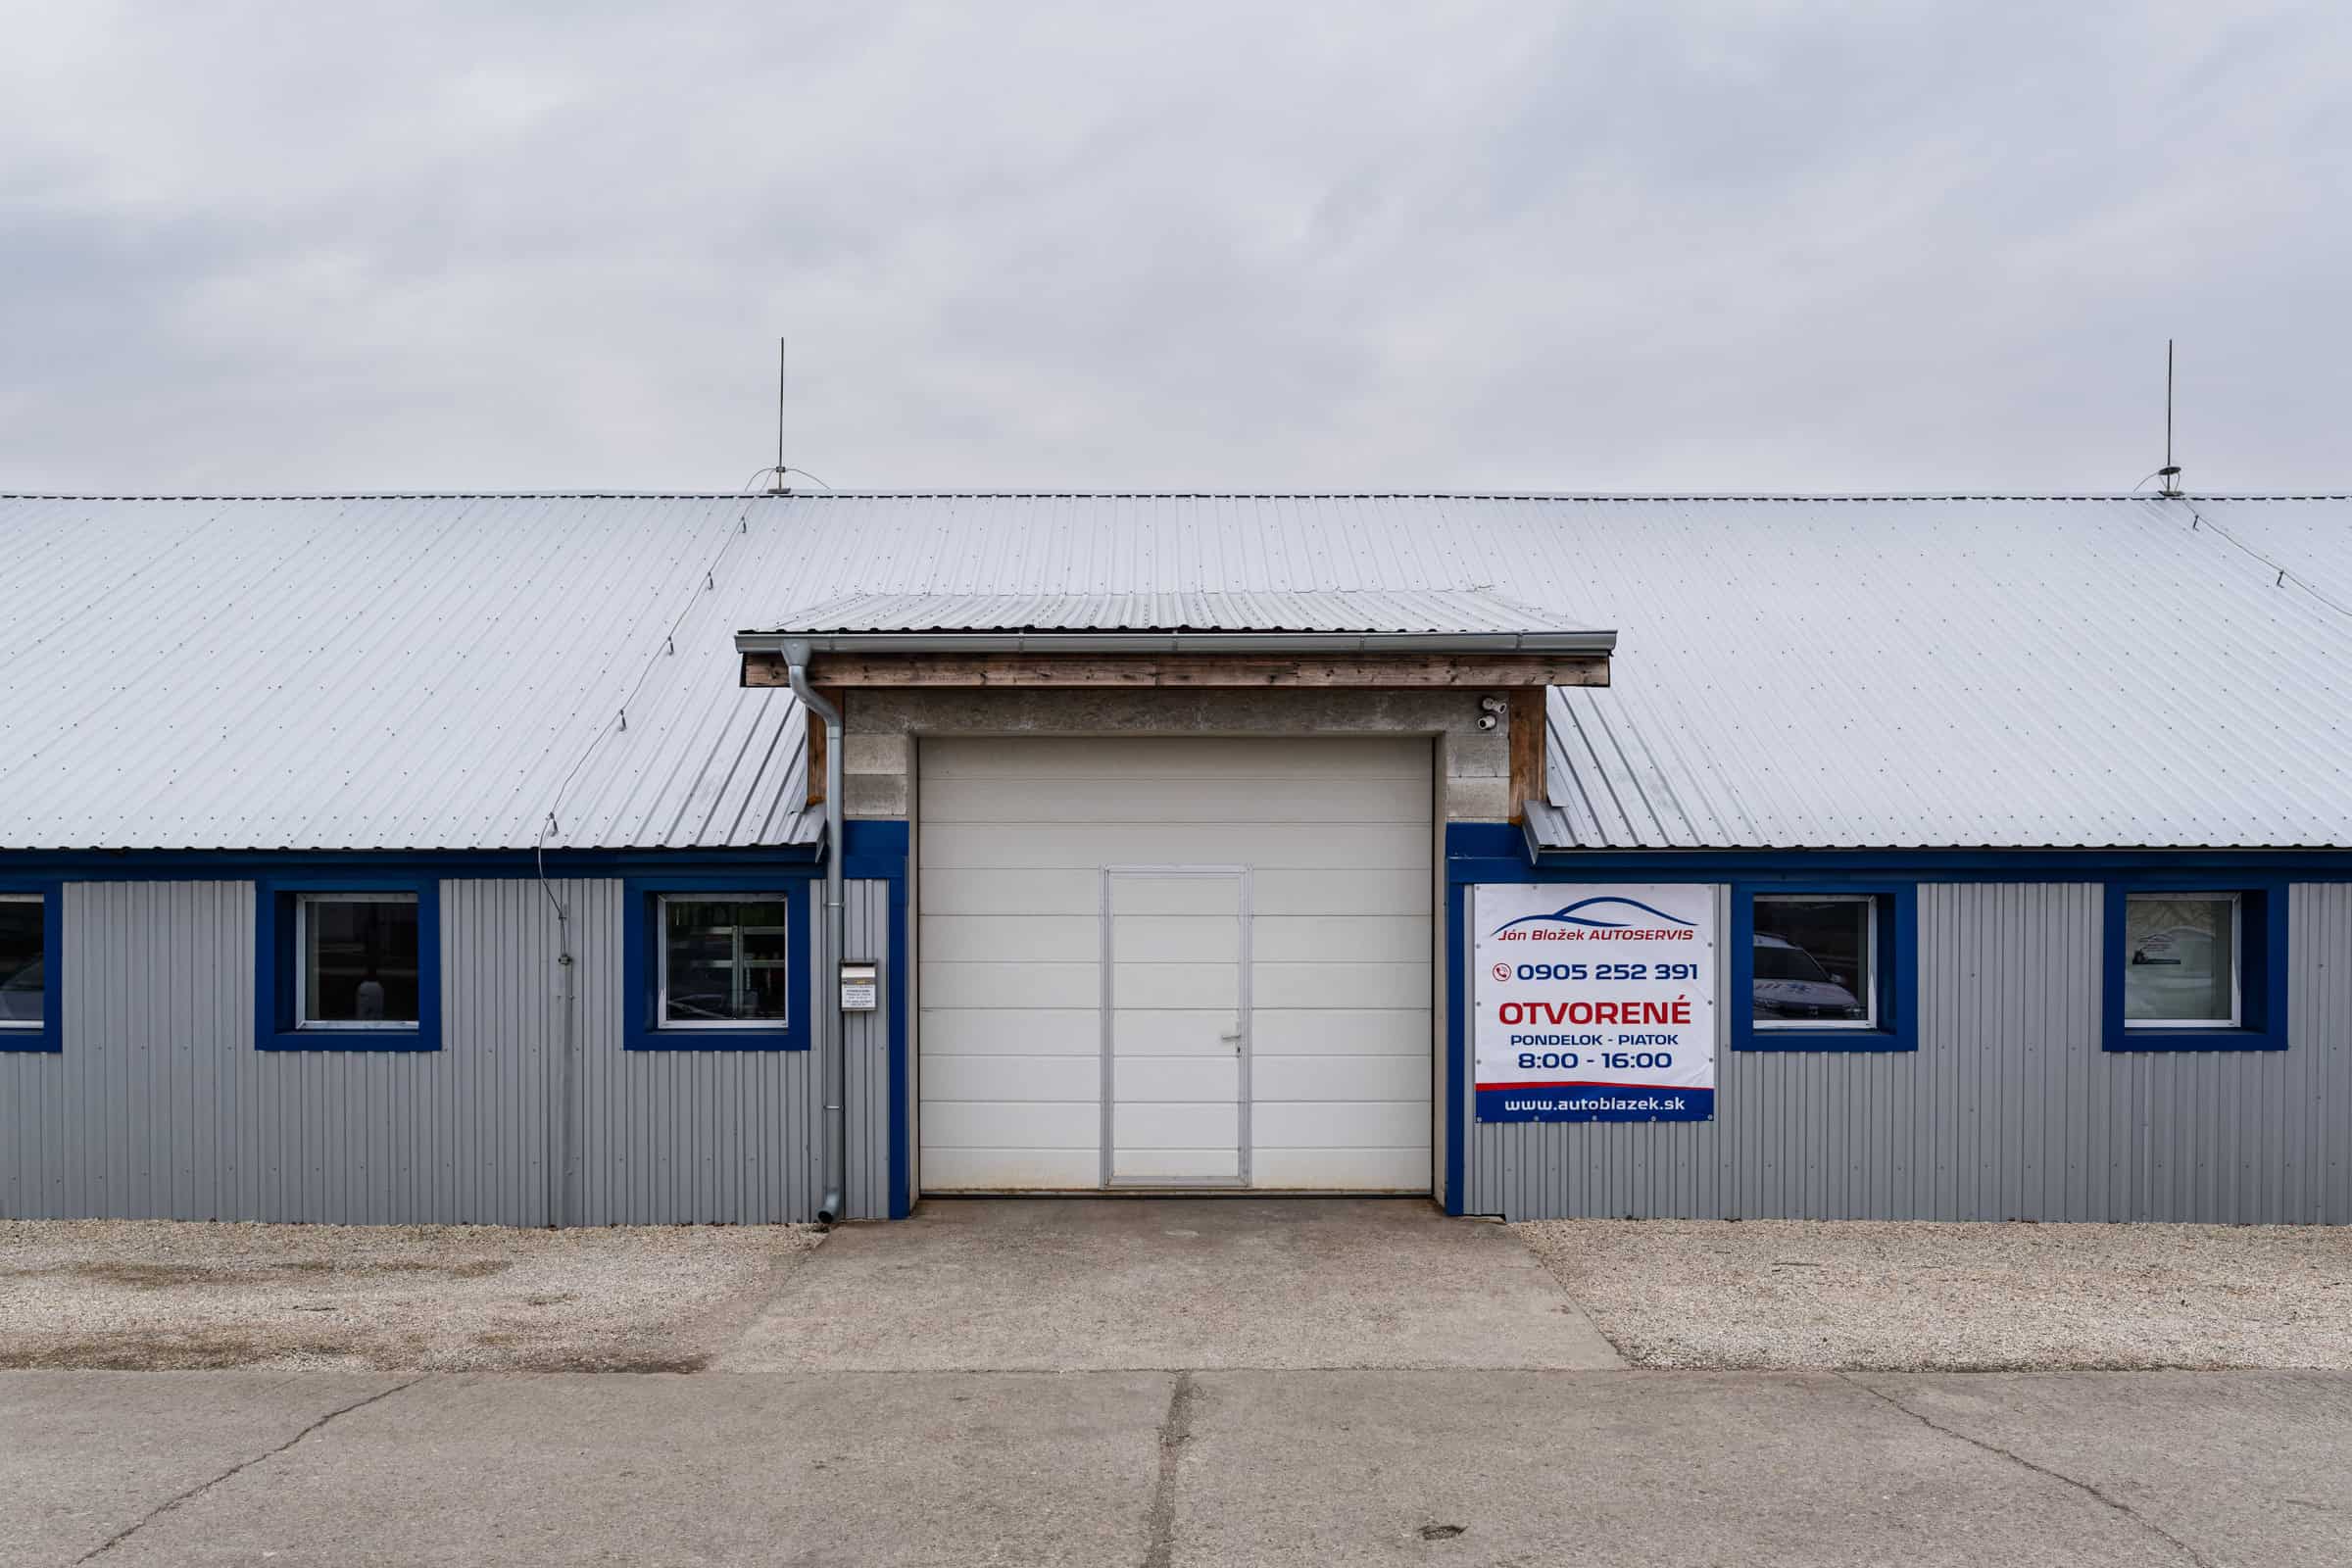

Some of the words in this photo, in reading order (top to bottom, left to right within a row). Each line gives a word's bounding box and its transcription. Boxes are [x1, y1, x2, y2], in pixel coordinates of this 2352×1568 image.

[1497, 928, 1527, 941] Ján
[1532, 928, 1585, 941] Blažek
[1589, 929, 1694, 941] AUTOSERVIS
[1517, 963, 1588, 981] 0905
[1595, 964, 1647, 981] 252
[1654, 964, 1698, 981] 391
[1498, 995, 1691, 1025] OTVORENÉ
[1510, 1034, 1603, 1047] PONDELOK
[1618, 1034, 1679, 1046] PIATOK
[1518, 1053, 1579, 1069] 8:00
[1601, 1053, 1673, 1069] 16:00
[1504, 1097, 1686, 1111] www.autoblazek.sk
